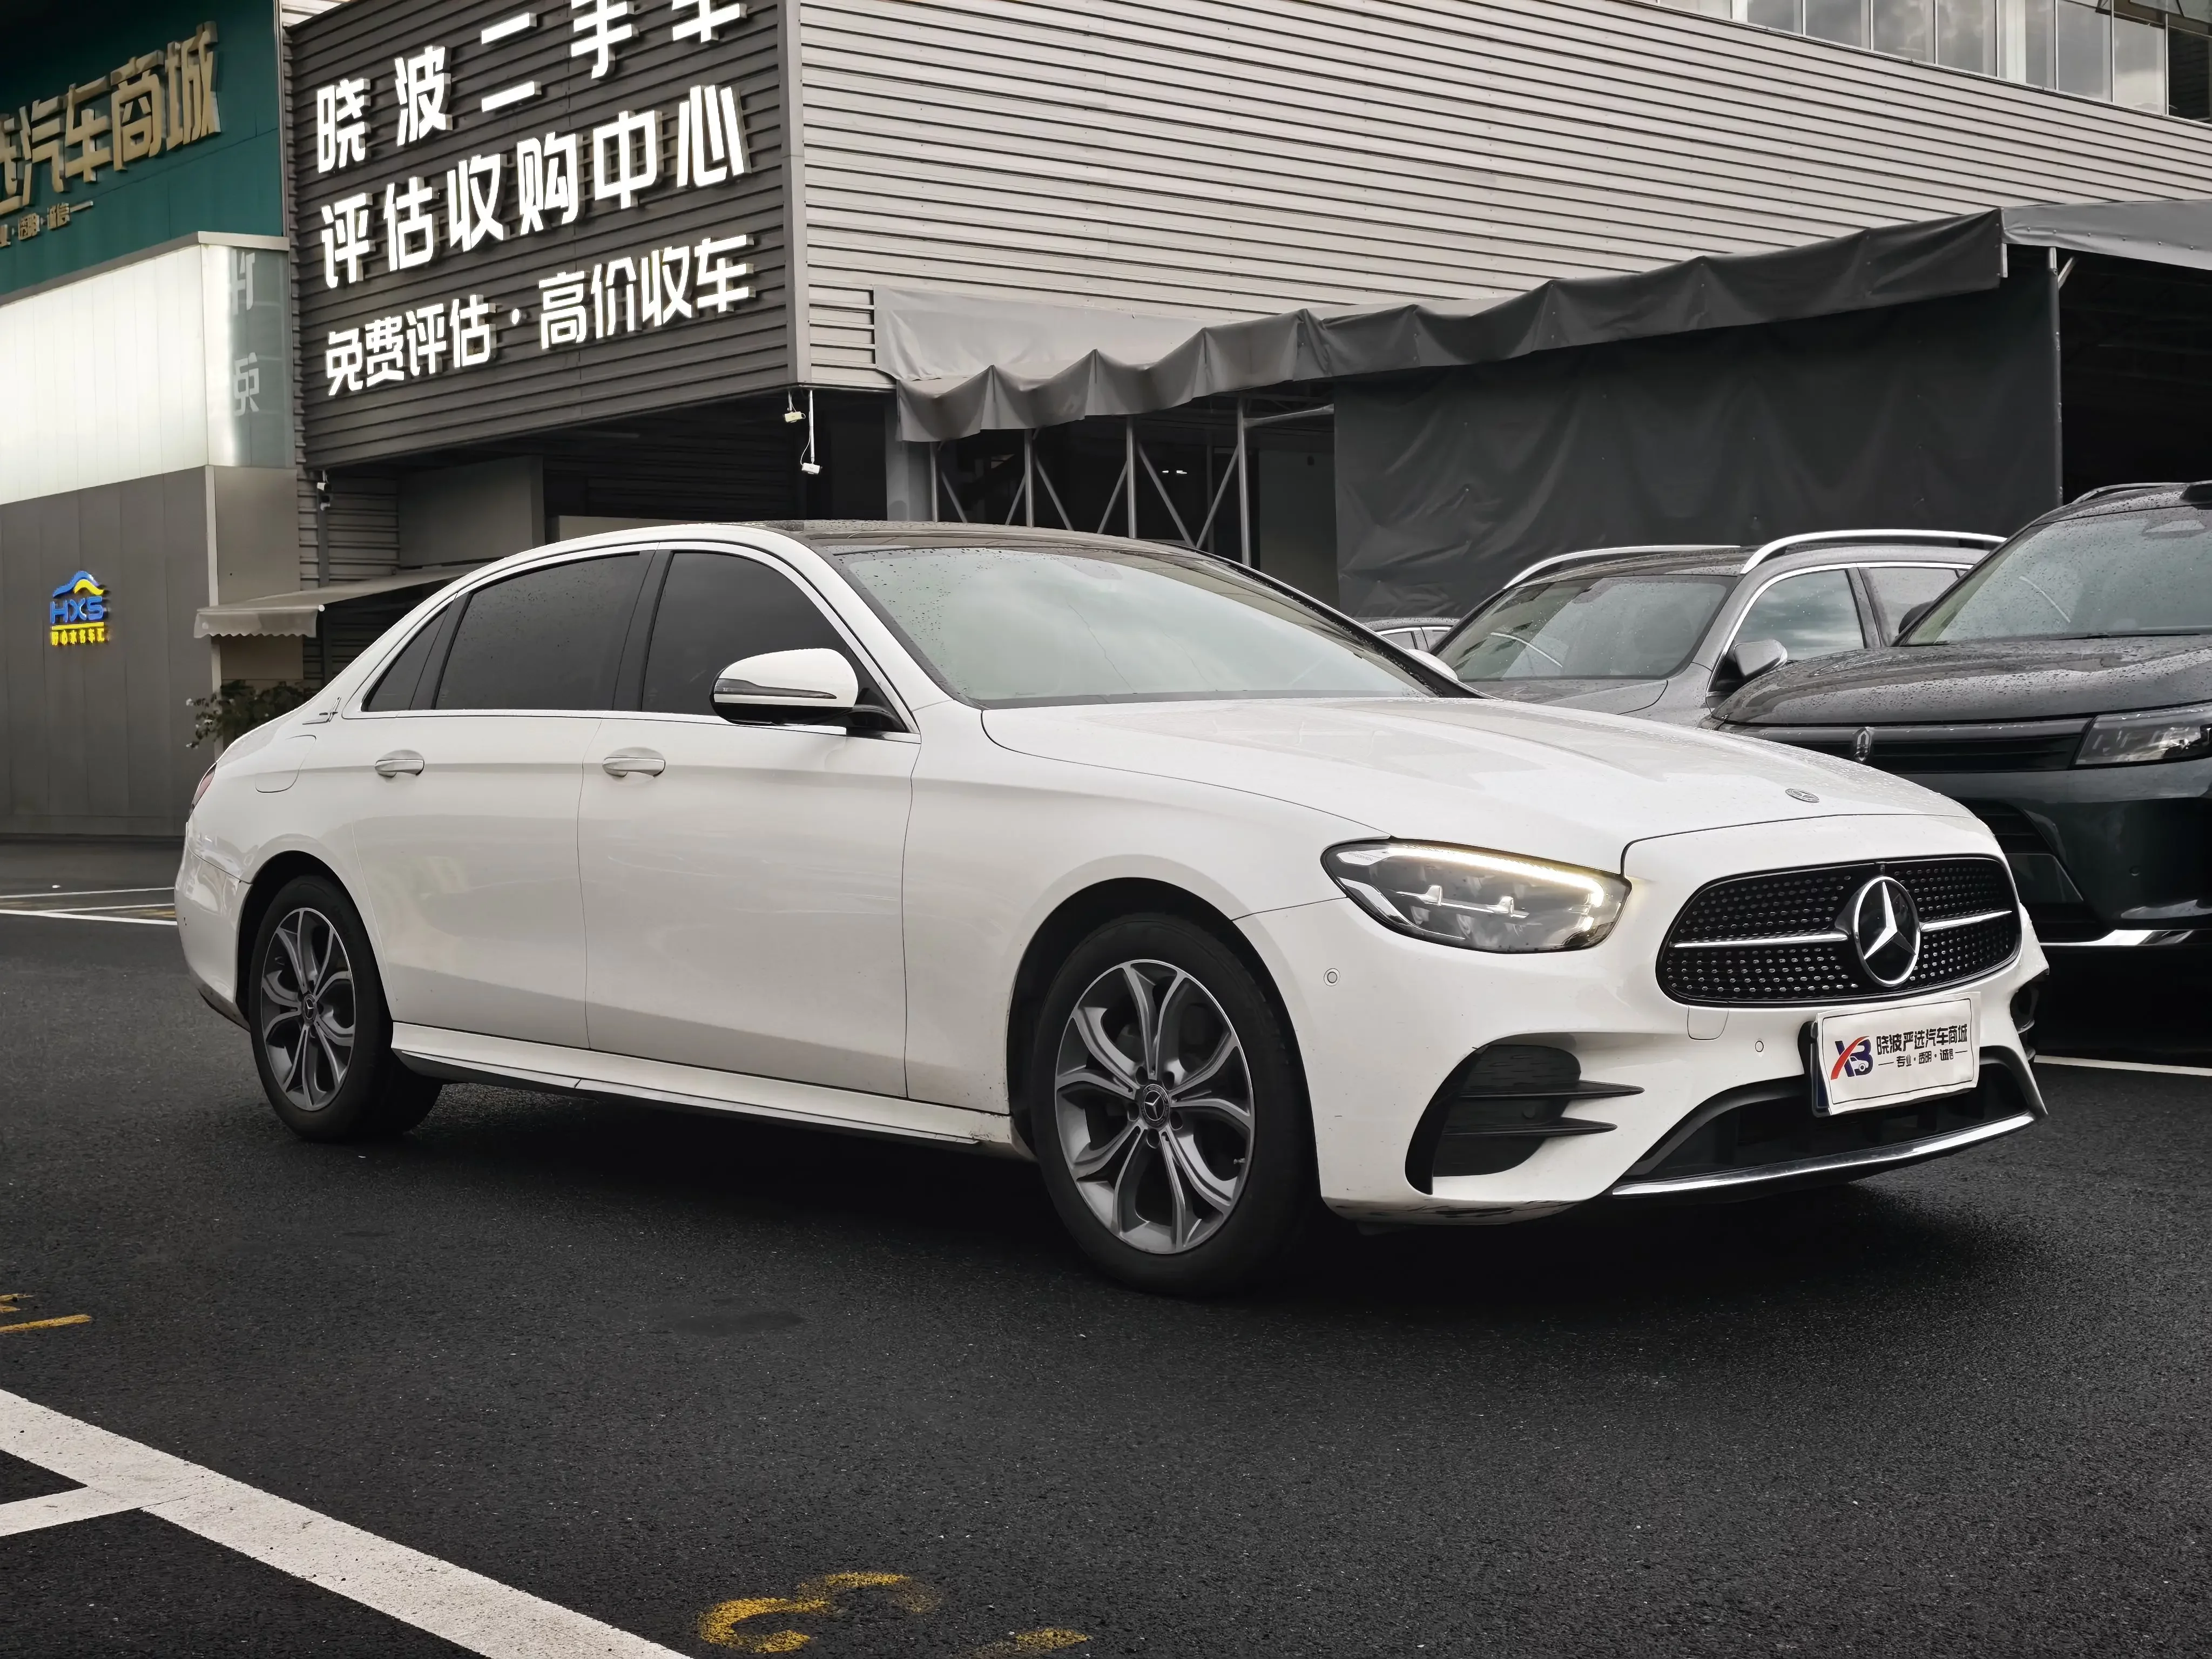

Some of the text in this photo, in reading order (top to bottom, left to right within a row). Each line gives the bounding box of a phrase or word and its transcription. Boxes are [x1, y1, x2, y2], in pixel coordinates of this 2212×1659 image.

[321, 84, 752, 288] 评估收购中心
[50, 596, 104, 624] HXS
[1876, 1023, 1968, 1055] 晓波严选汽车商城
